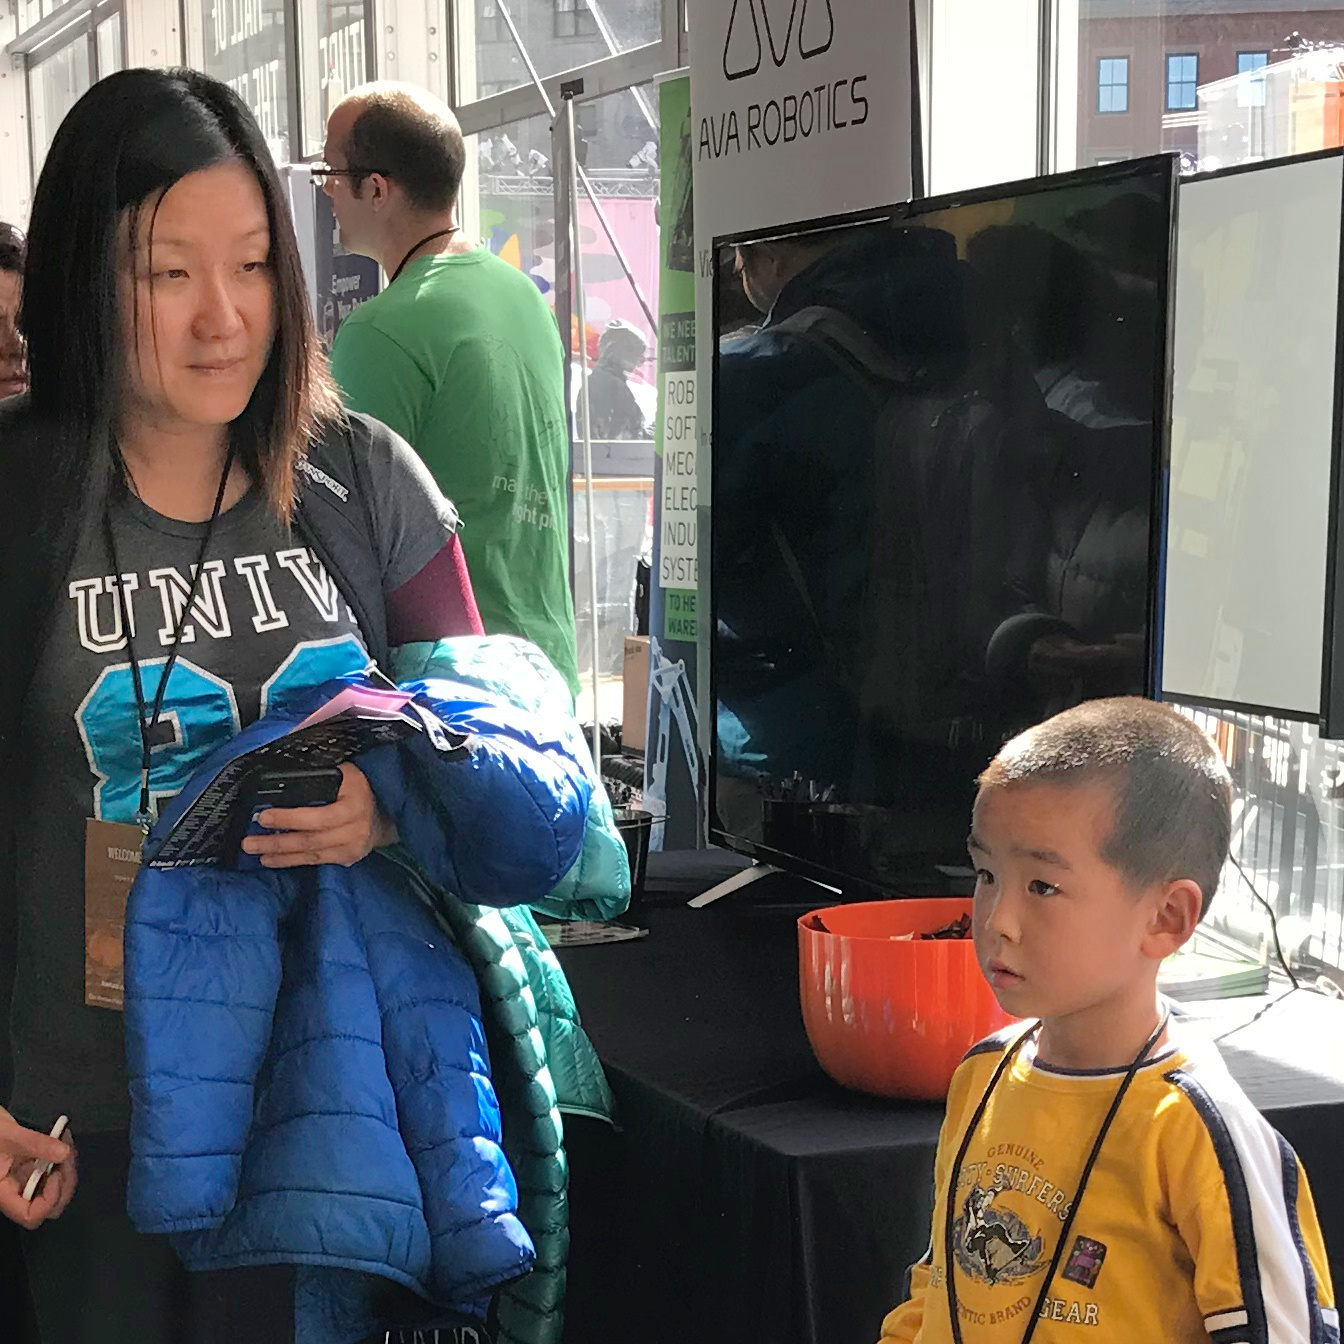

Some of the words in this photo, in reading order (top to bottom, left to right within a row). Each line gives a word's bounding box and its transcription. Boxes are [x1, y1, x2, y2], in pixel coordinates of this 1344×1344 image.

[698, 110, 741, 162] AVA
[747, 75, 869, 150] ROBOTICS
[668, 380, 696, 406] ROB
[665, 451, 697, 476] MEC
[665, 486, 697, 511] ELEC
[664, 521, 696, 546] INDU
[69, 548, 358, 653] UNIV
[683, 596, 696, 612] HE
[668, 619, 696, 637] WARE
[987, 1143, 1045, 1171] GENUINE
[992, 1162, 1074, 1222] SURFERS
[989, 1296, 1032, 1325] BRAND
[1039, 1297, 1099, 1325] GEAR
